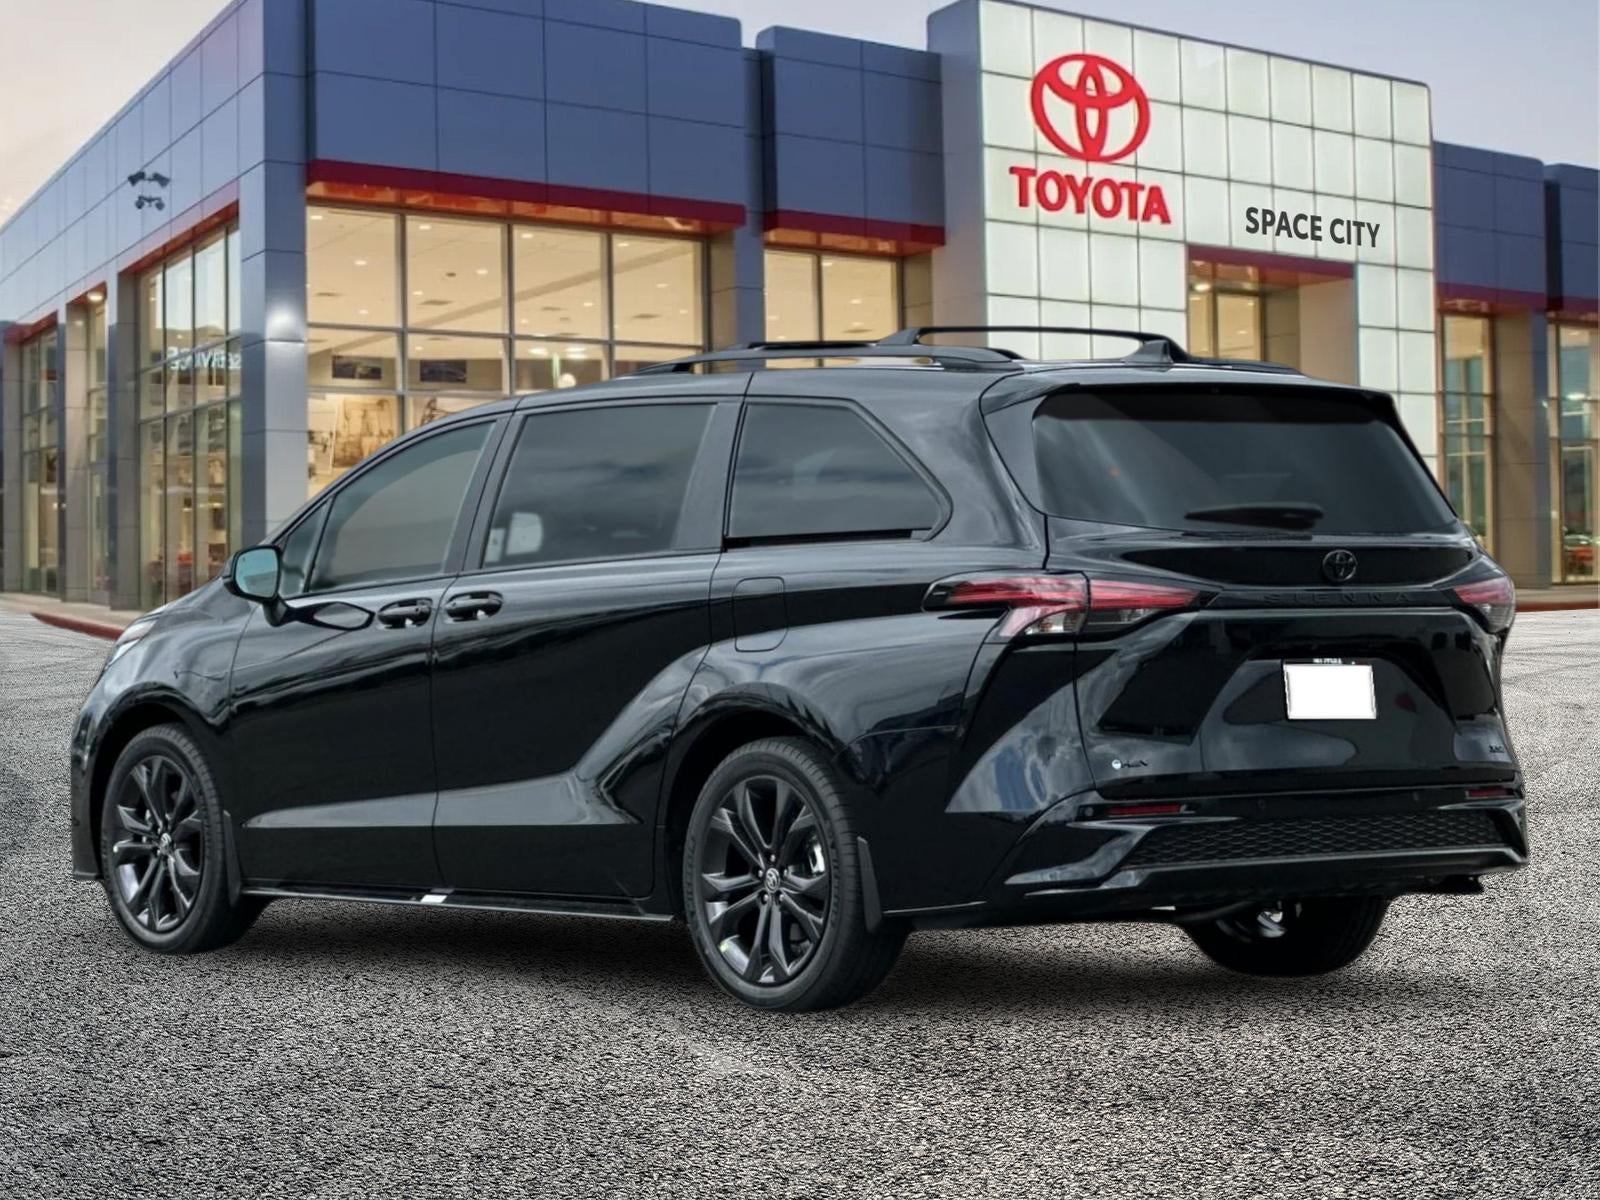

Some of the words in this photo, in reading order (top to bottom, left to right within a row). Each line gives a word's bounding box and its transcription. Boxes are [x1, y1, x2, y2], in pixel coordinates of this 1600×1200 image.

[1009, 166, 1171, 224] TOYOTA
[1245, 207, 1322, 241] SPACE
[1329, 218, 1381, 248] CITY
[1264, 590, 1410, 602] SIENNA
